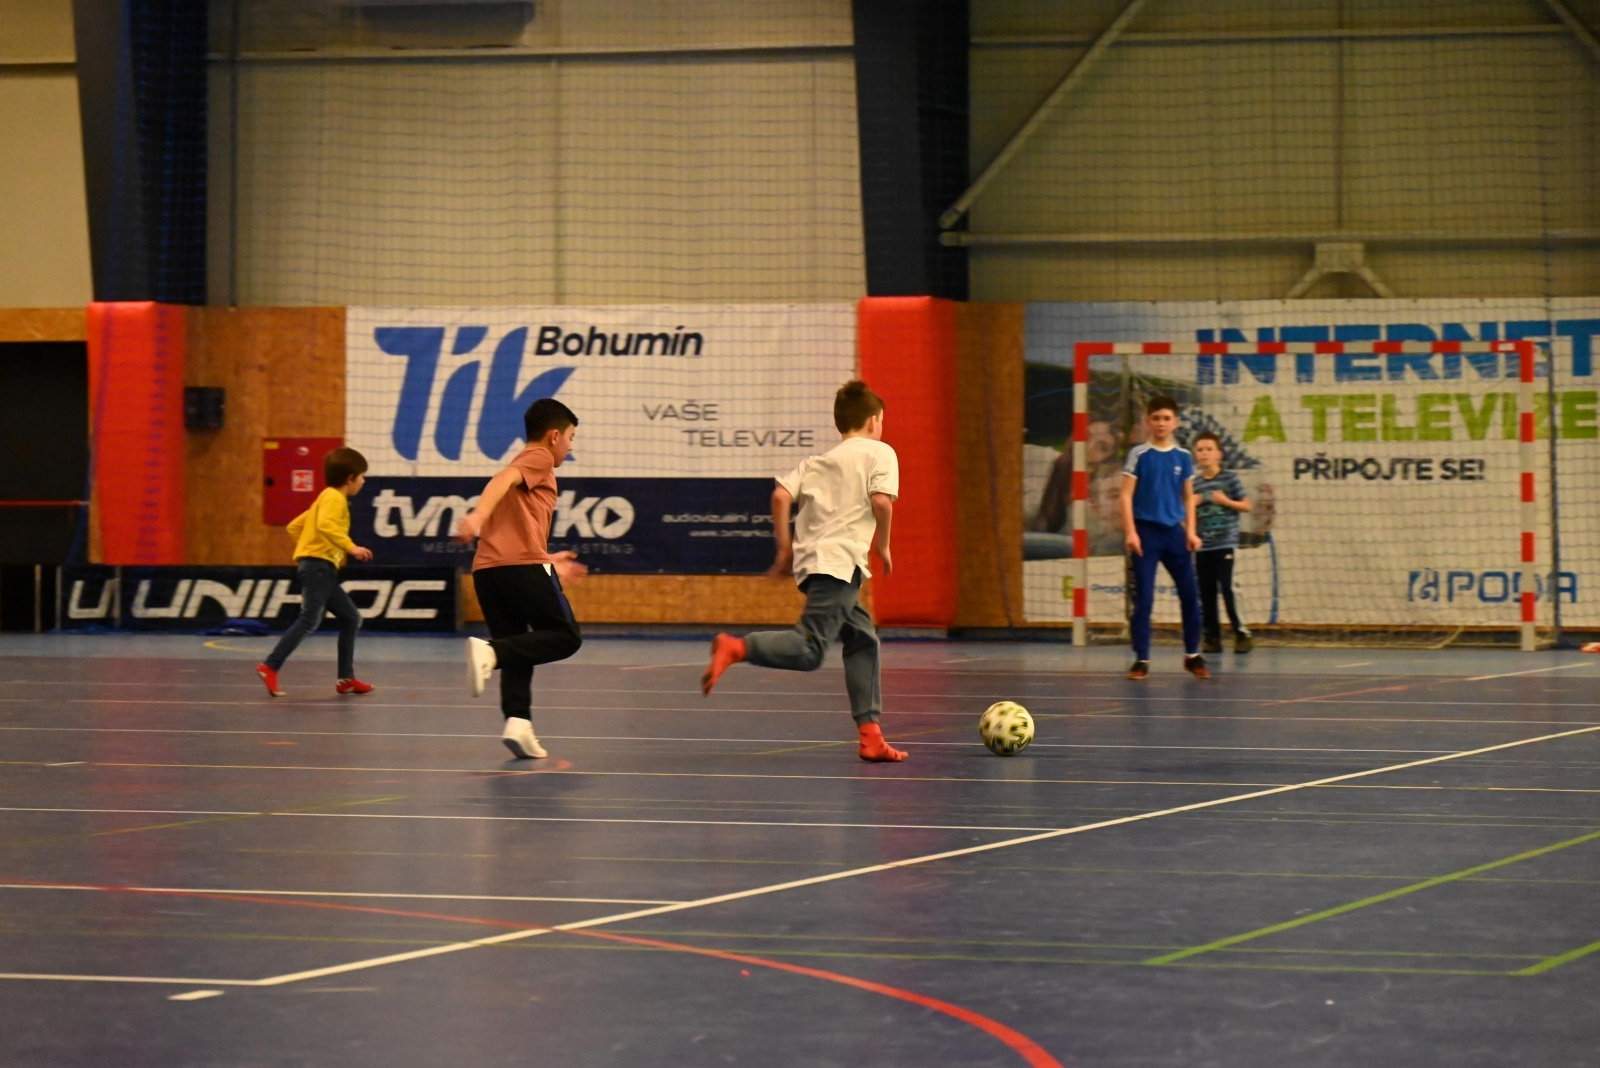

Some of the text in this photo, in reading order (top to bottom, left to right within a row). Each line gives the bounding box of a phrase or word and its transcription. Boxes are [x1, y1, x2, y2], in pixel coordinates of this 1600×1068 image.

[535, 325, 703, 356] Bohumín
[1196, 319, 1600, 385] INTERNET
[642, 400, 718, 420] VAŠE
[1243, 395, 1287, 442] A
[682, 430, 814, 447] TELEVIZE
[1294, 452, 1485, 480] PŘIPOJTE SE!
[372, 489, 634, 539] tvmko
